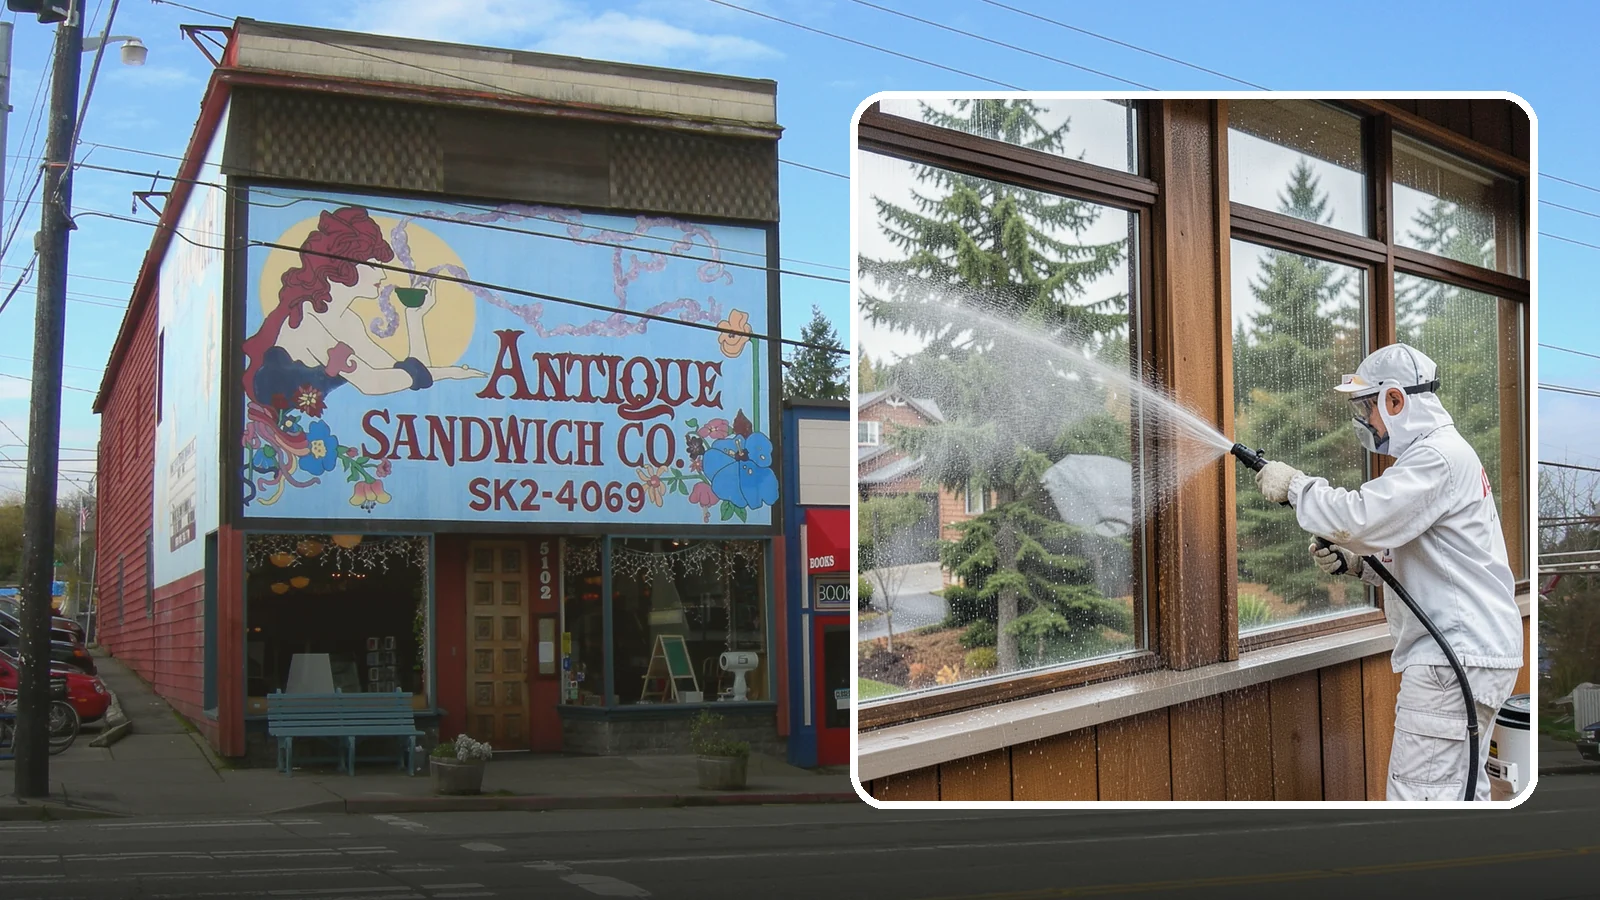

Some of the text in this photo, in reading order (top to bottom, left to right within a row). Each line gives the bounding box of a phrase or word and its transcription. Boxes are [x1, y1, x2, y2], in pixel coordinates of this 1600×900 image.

[476, 328, 723, 420] ANTIQUE
[361, 408, 684, 468] SANDWICH CO.
[468, 477, 646, 513] SK2-4069
[540, 541, 551, 599] 5102
[809, 555, 835, 569] BOOKS
